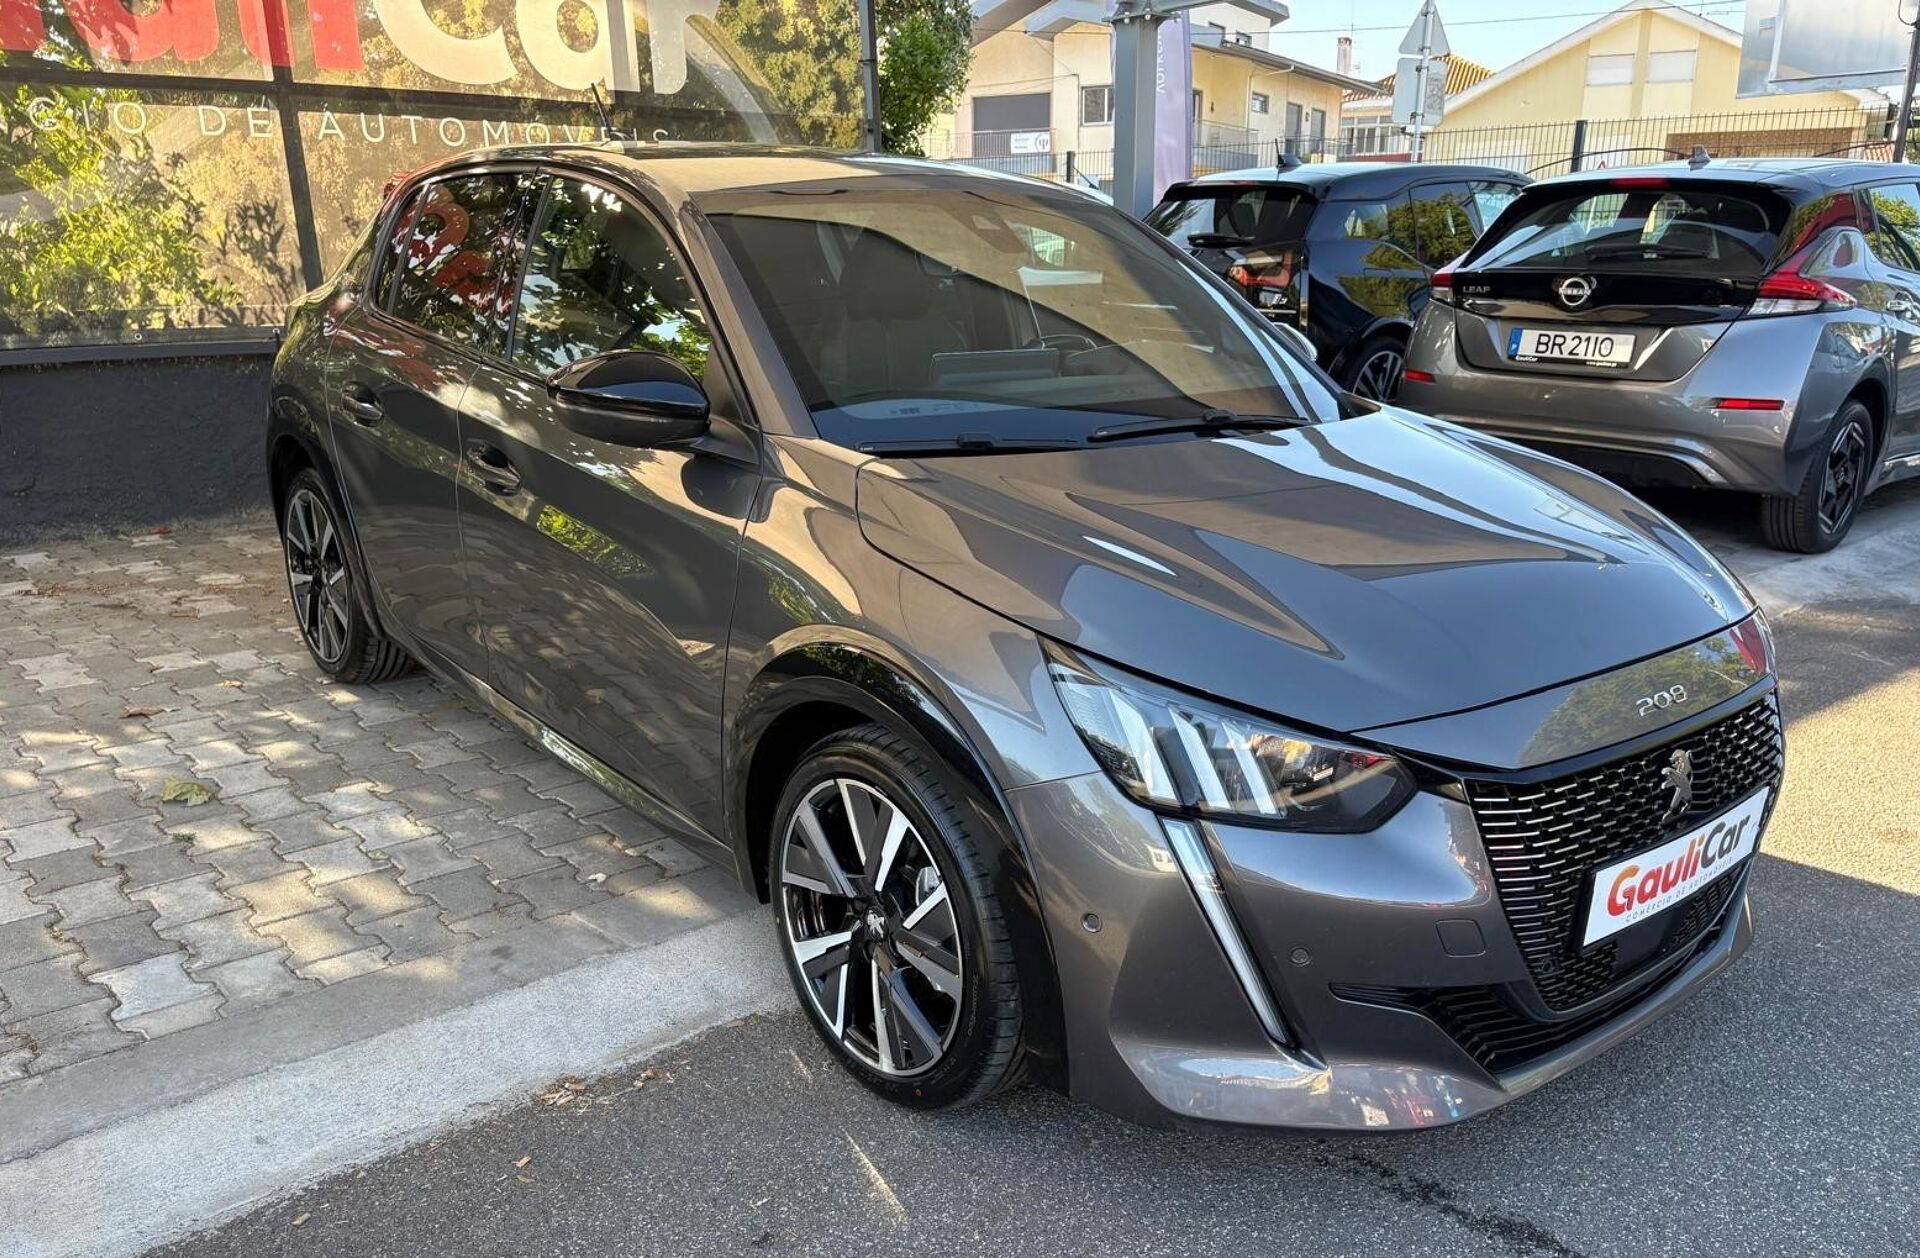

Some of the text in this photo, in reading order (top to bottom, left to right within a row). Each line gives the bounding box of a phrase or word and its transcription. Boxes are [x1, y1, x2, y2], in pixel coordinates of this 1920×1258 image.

[199, 104, 272, 138] DE
[1462, 285, 1491, 294] LEAF
[1636, 685, 1688, 716] 208
[1607, 814, 1751, 917] GauliCar
